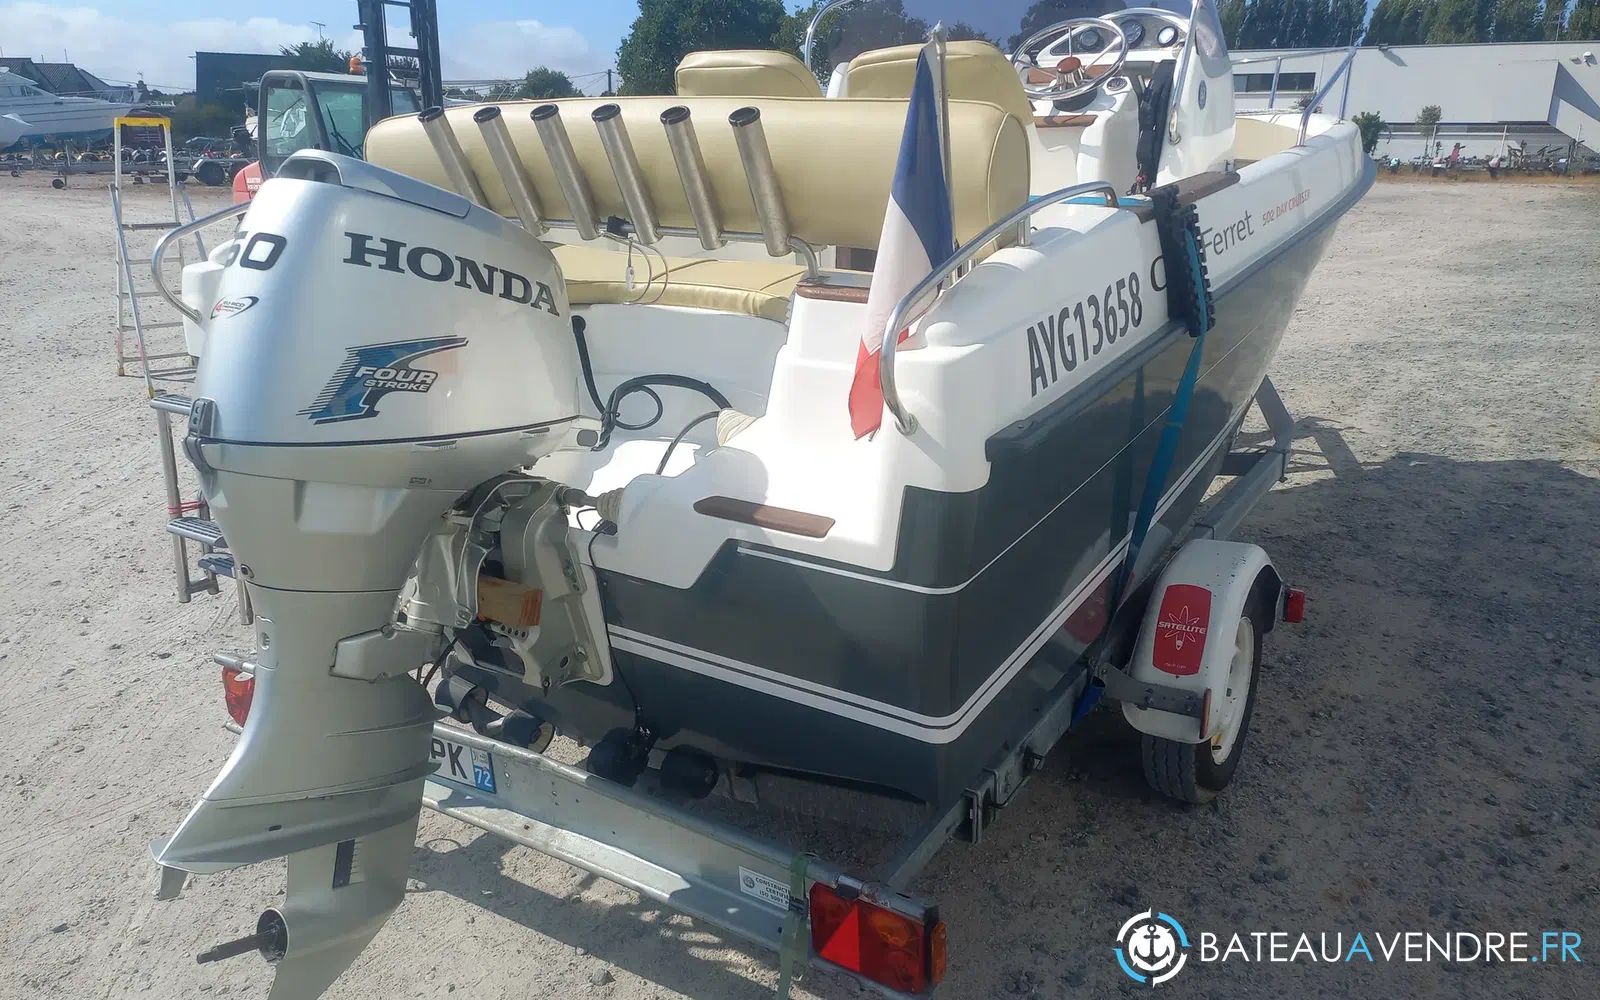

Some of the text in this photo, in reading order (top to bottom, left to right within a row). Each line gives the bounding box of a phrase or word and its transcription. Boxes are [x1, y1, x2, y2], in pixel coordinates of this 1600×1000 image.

[1201, 210, 1254, 263] Ferret
[1262, 210, 1275, 227] 502
[343, 232, 560, 317] HONDA
[1026, 271, 1142, 398] AYG13658
[355, 366, 437, 384] FOUR
[364, 380, 430, 391] STROKE
[1158, 621, 1207, 634] SATELLITE
[474, 767, 492, 787] 72
